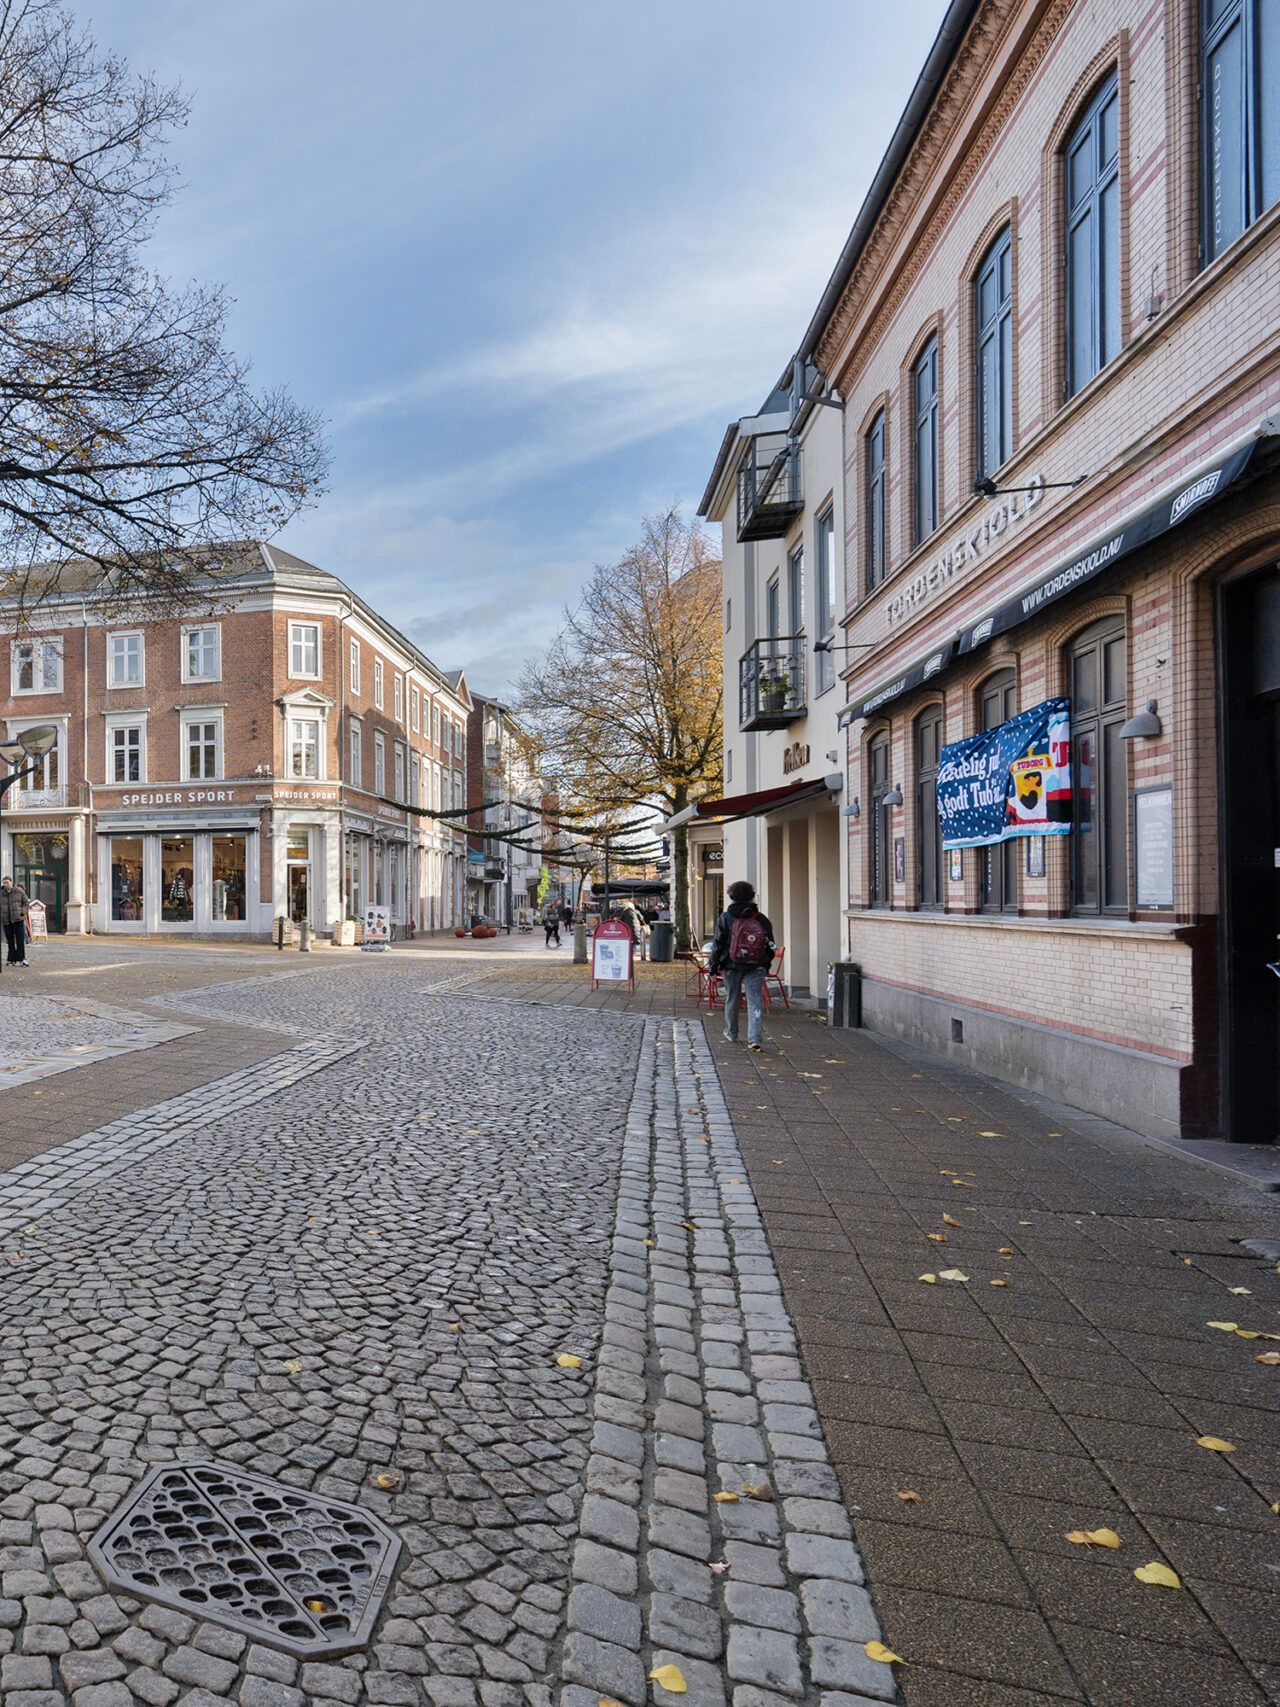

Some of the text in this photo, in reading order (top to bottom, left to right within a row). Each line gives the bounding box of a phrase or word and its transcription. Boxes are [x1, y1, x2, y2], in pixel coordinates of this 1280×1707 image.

[1173, 477, 1218, 518] SMIRNOFF
[885, 473, 1046, 626] TORDENSKIOLD
[1021, 534, 1125, 614] WWW.TORDENSKIOLD.NU
[1016, 758, 1044, 770] TUBORG
[122, 790, 236, 806] SPEJDER SPORT
[273, 791, 309, 800] SPEJDER
[311, 791, 337, 800] SPORT
[944, 785, 970, 818] godt
